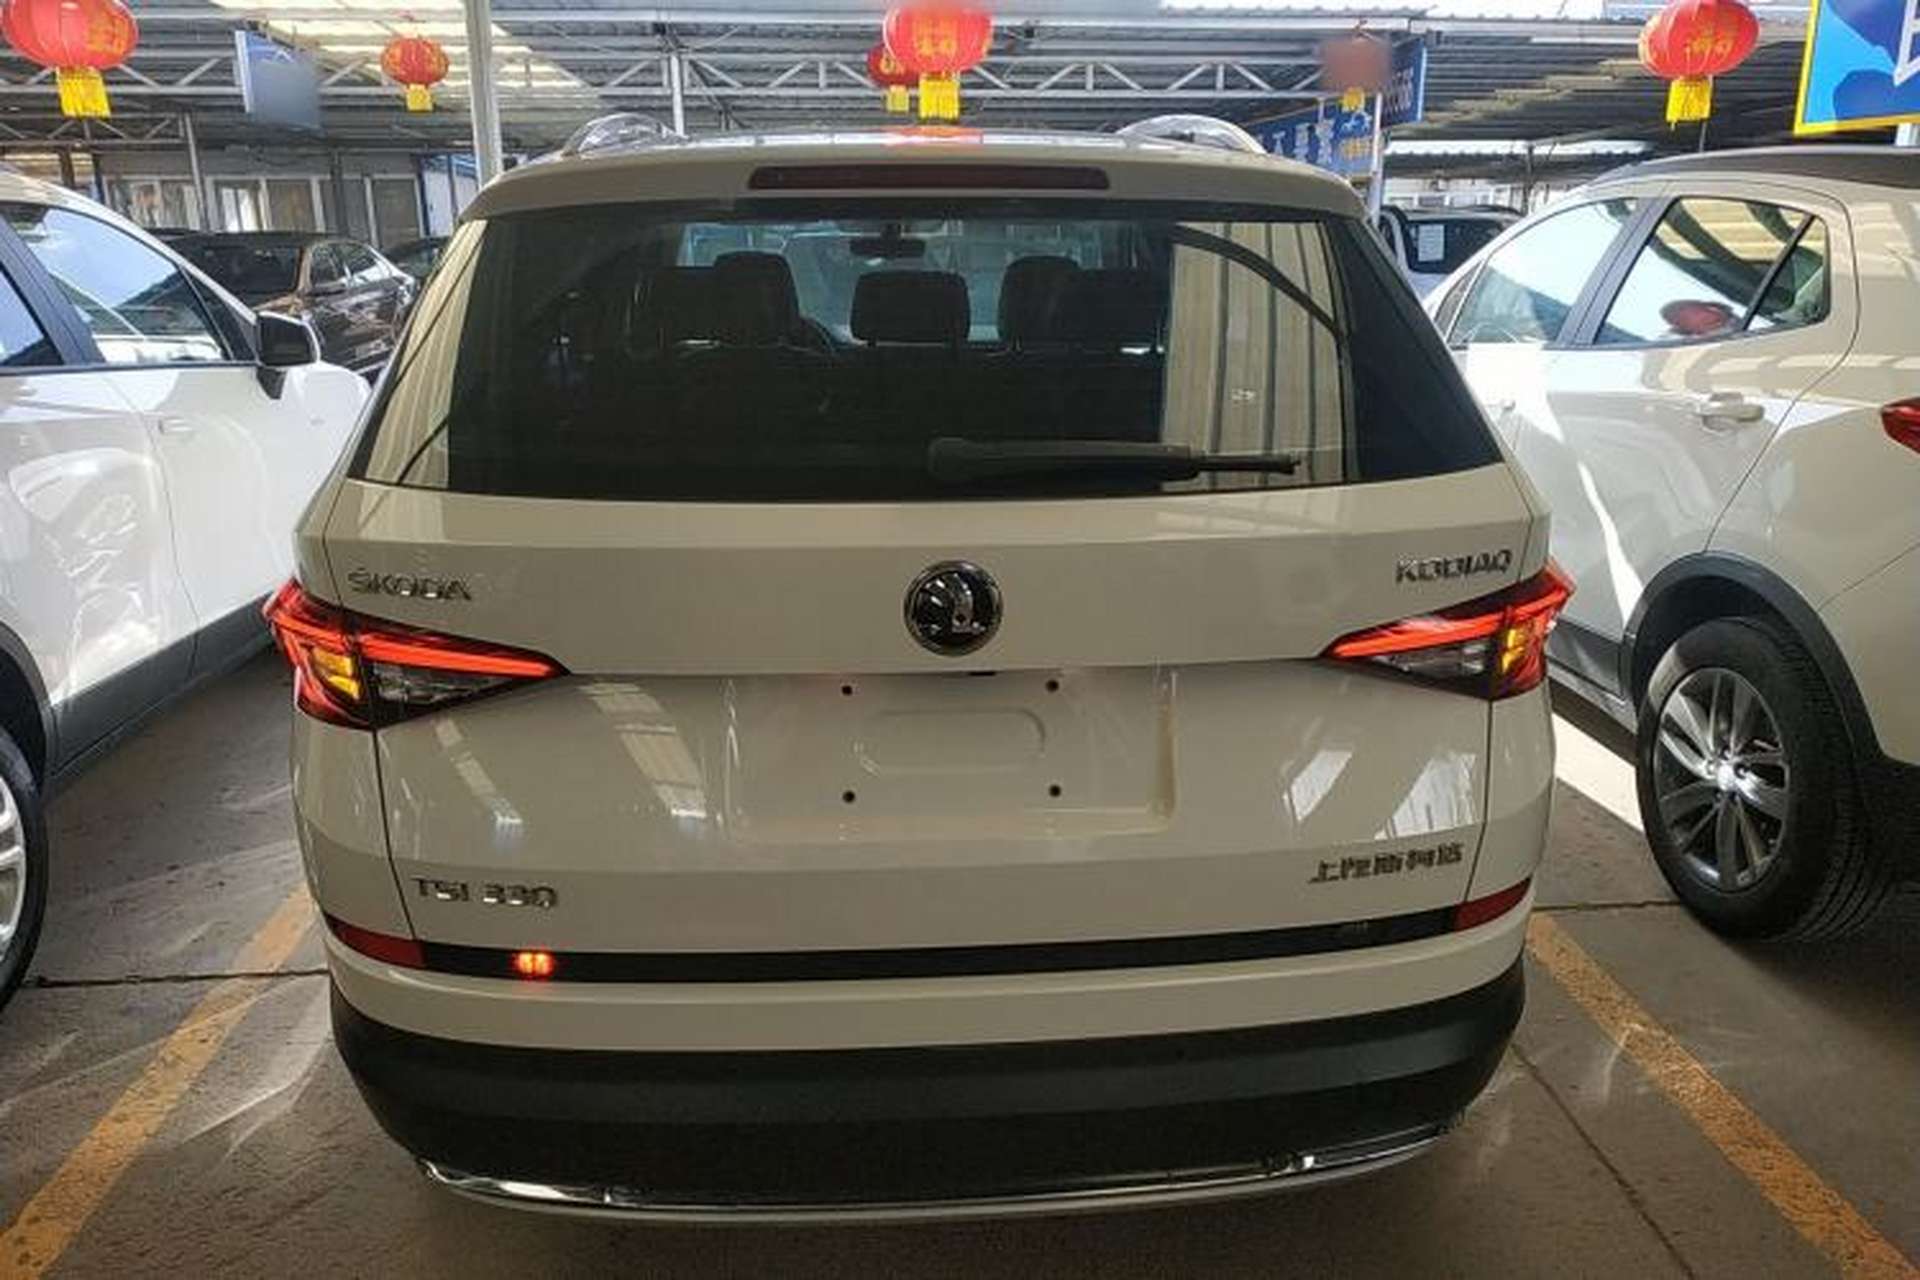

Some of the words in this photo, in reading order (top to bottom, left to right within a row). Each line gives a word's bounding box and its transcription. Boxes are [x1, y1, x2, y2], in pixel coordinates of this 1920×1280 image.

[1396, 549, 1513, 583] KODIAQ
[411, 877, 469, 902] TSI
[483, 883, 558, 908] 330
